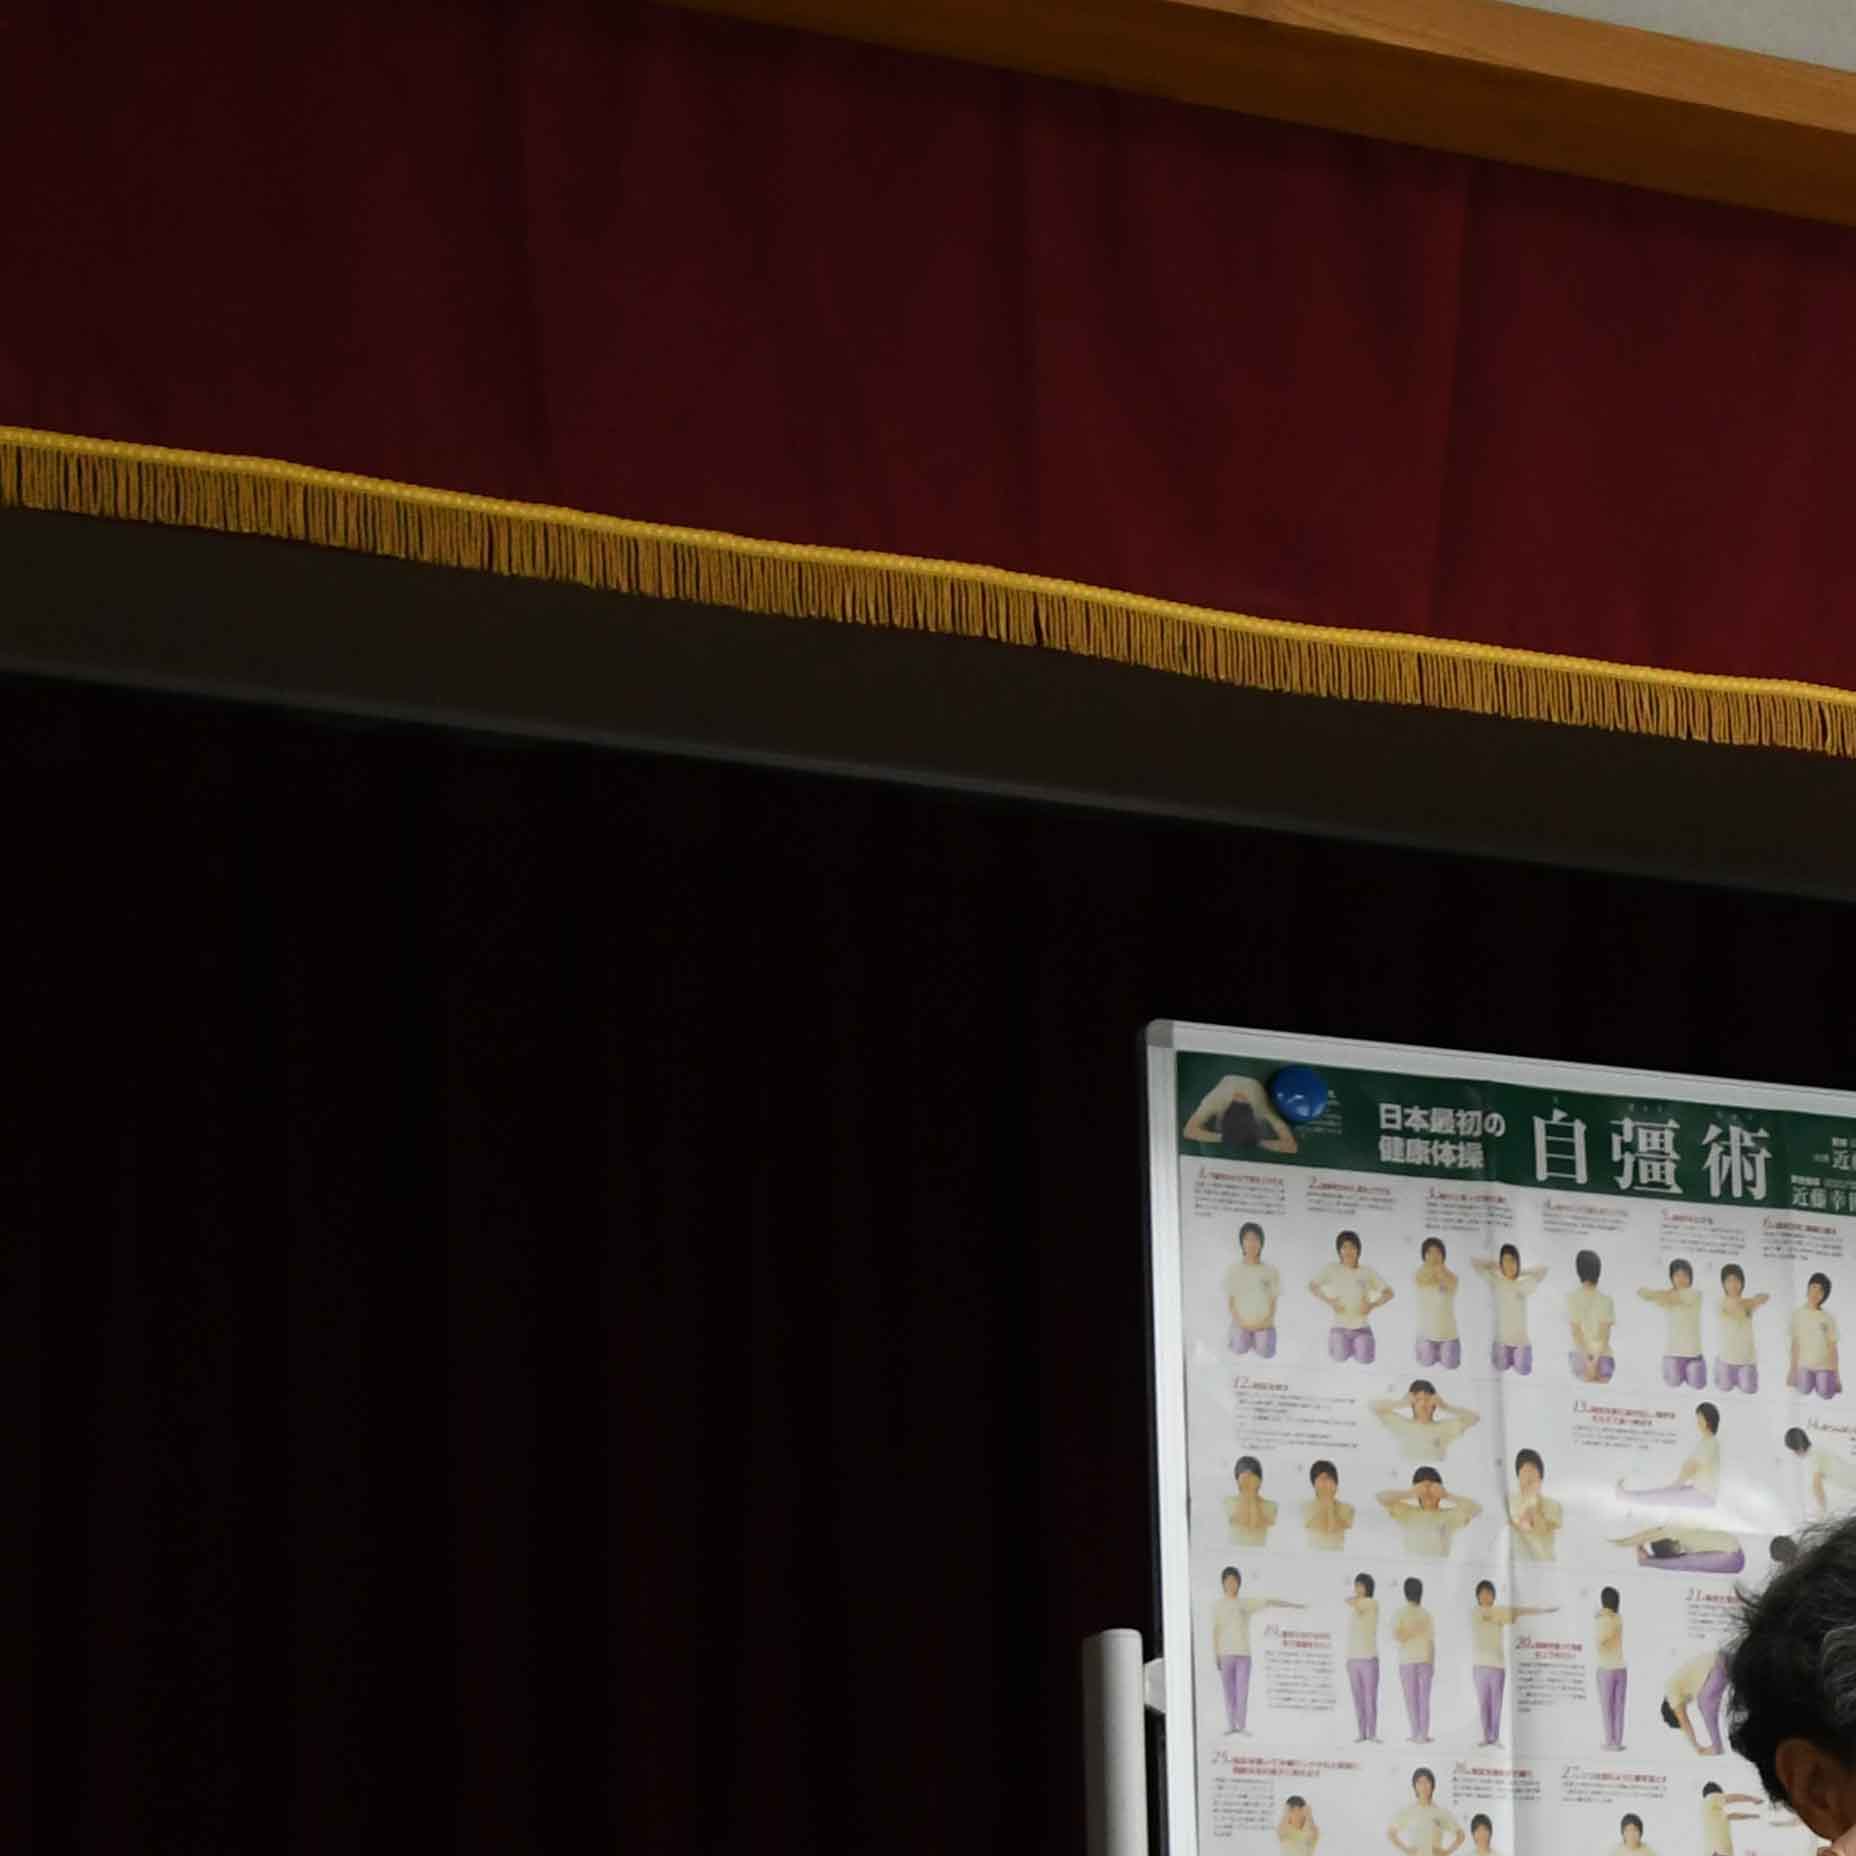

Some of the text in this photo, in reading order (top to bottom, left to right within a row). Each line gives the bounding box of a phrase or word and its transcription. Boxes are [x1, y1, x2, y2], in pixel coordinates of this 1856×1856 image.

[1379, 1103, 1505, 1137] 日本最初の
[1379, 1135, 1484, 1169] 健康体操
